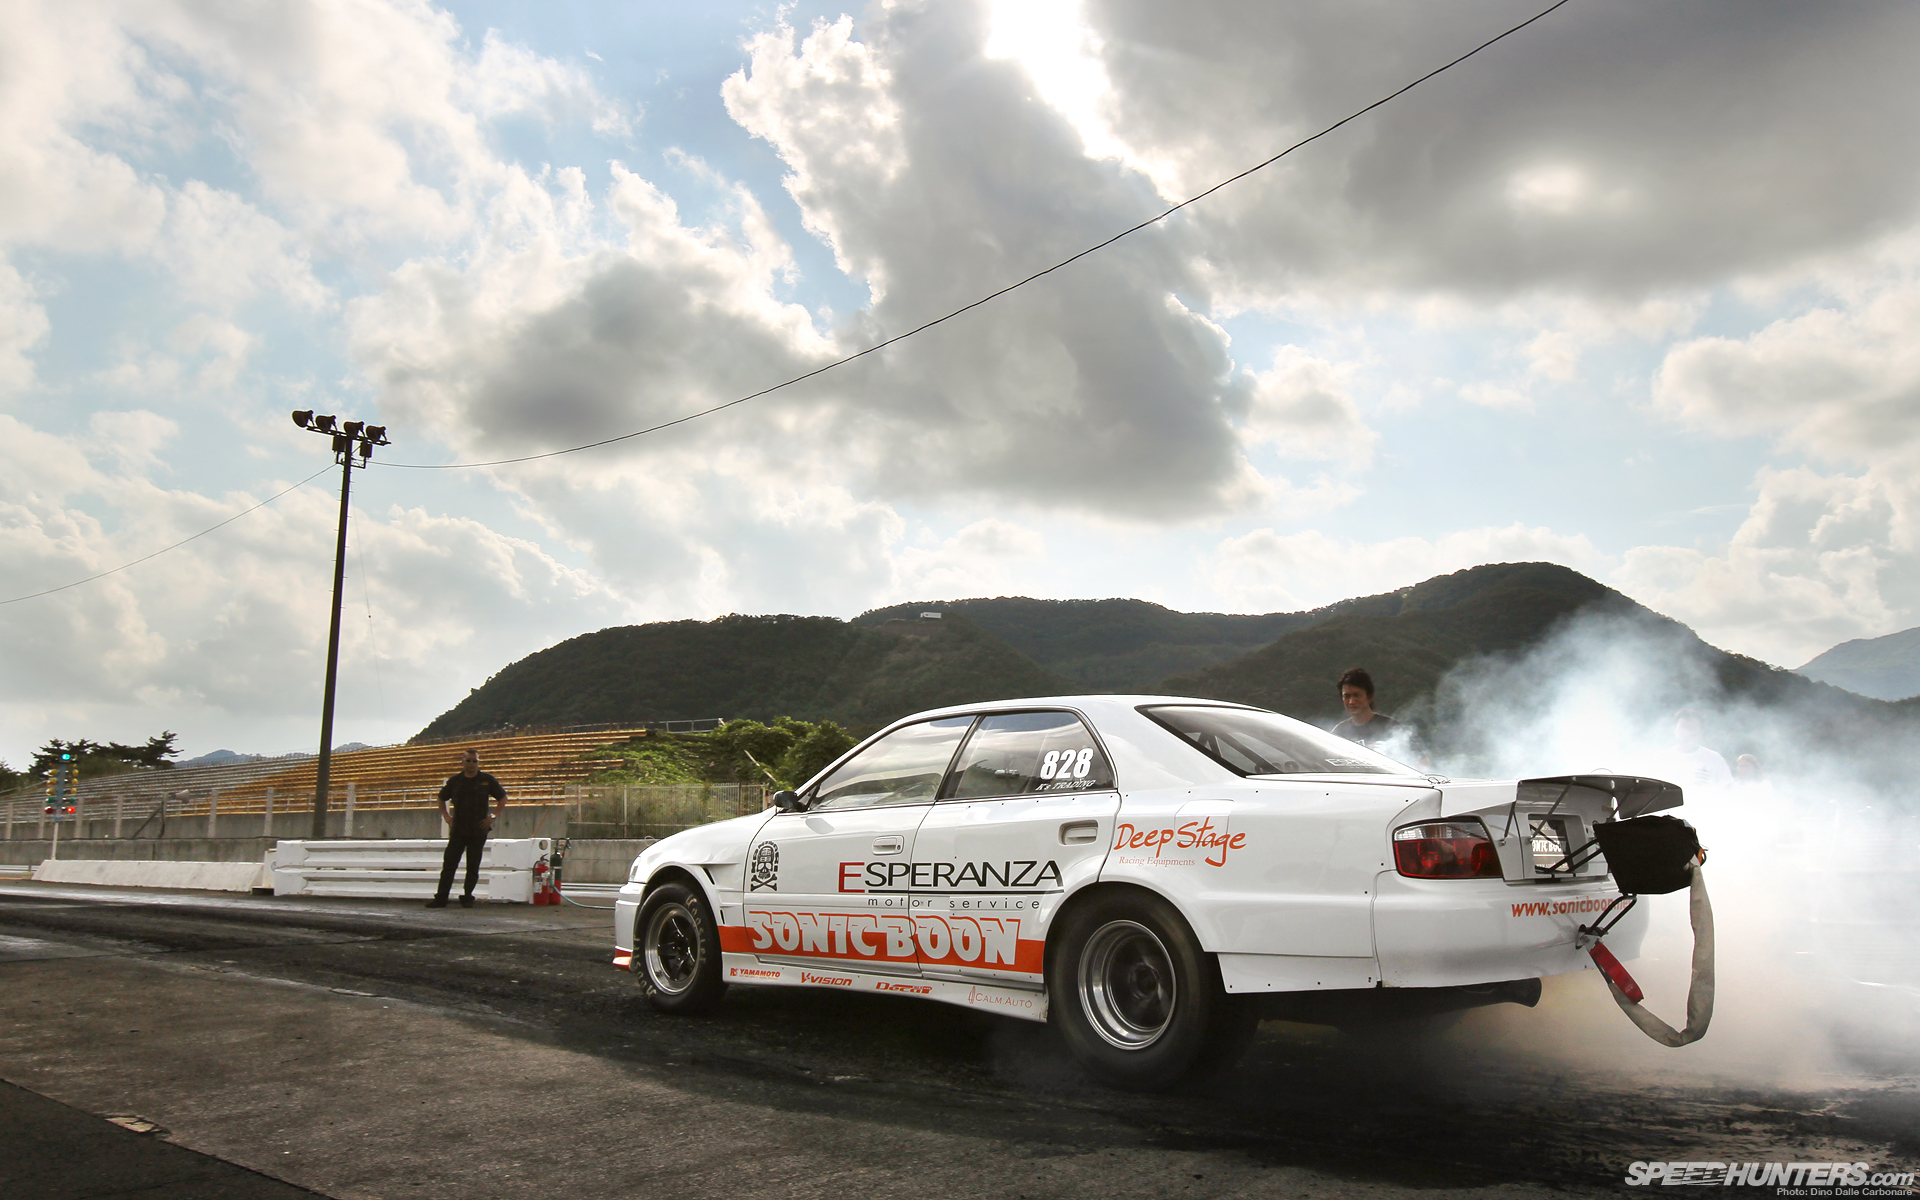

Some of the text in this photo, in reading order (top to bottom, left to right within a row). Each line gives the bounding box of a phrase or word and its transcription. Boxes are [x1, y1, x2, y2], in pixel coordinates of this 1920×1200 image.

[1040, 747, 1094, 780] 828
[1118, 856, 1196, 867] Racing Equipments
[838, 860, 1064, 893] ESPERANZA
[868, 897, 1040, 909] motor service
[749, 911, 1021, 965] SONIC BOON
[739, 968, 781, 978] YAMAMOTO
[975, 992, 1033, 1009] CALM AUTO
